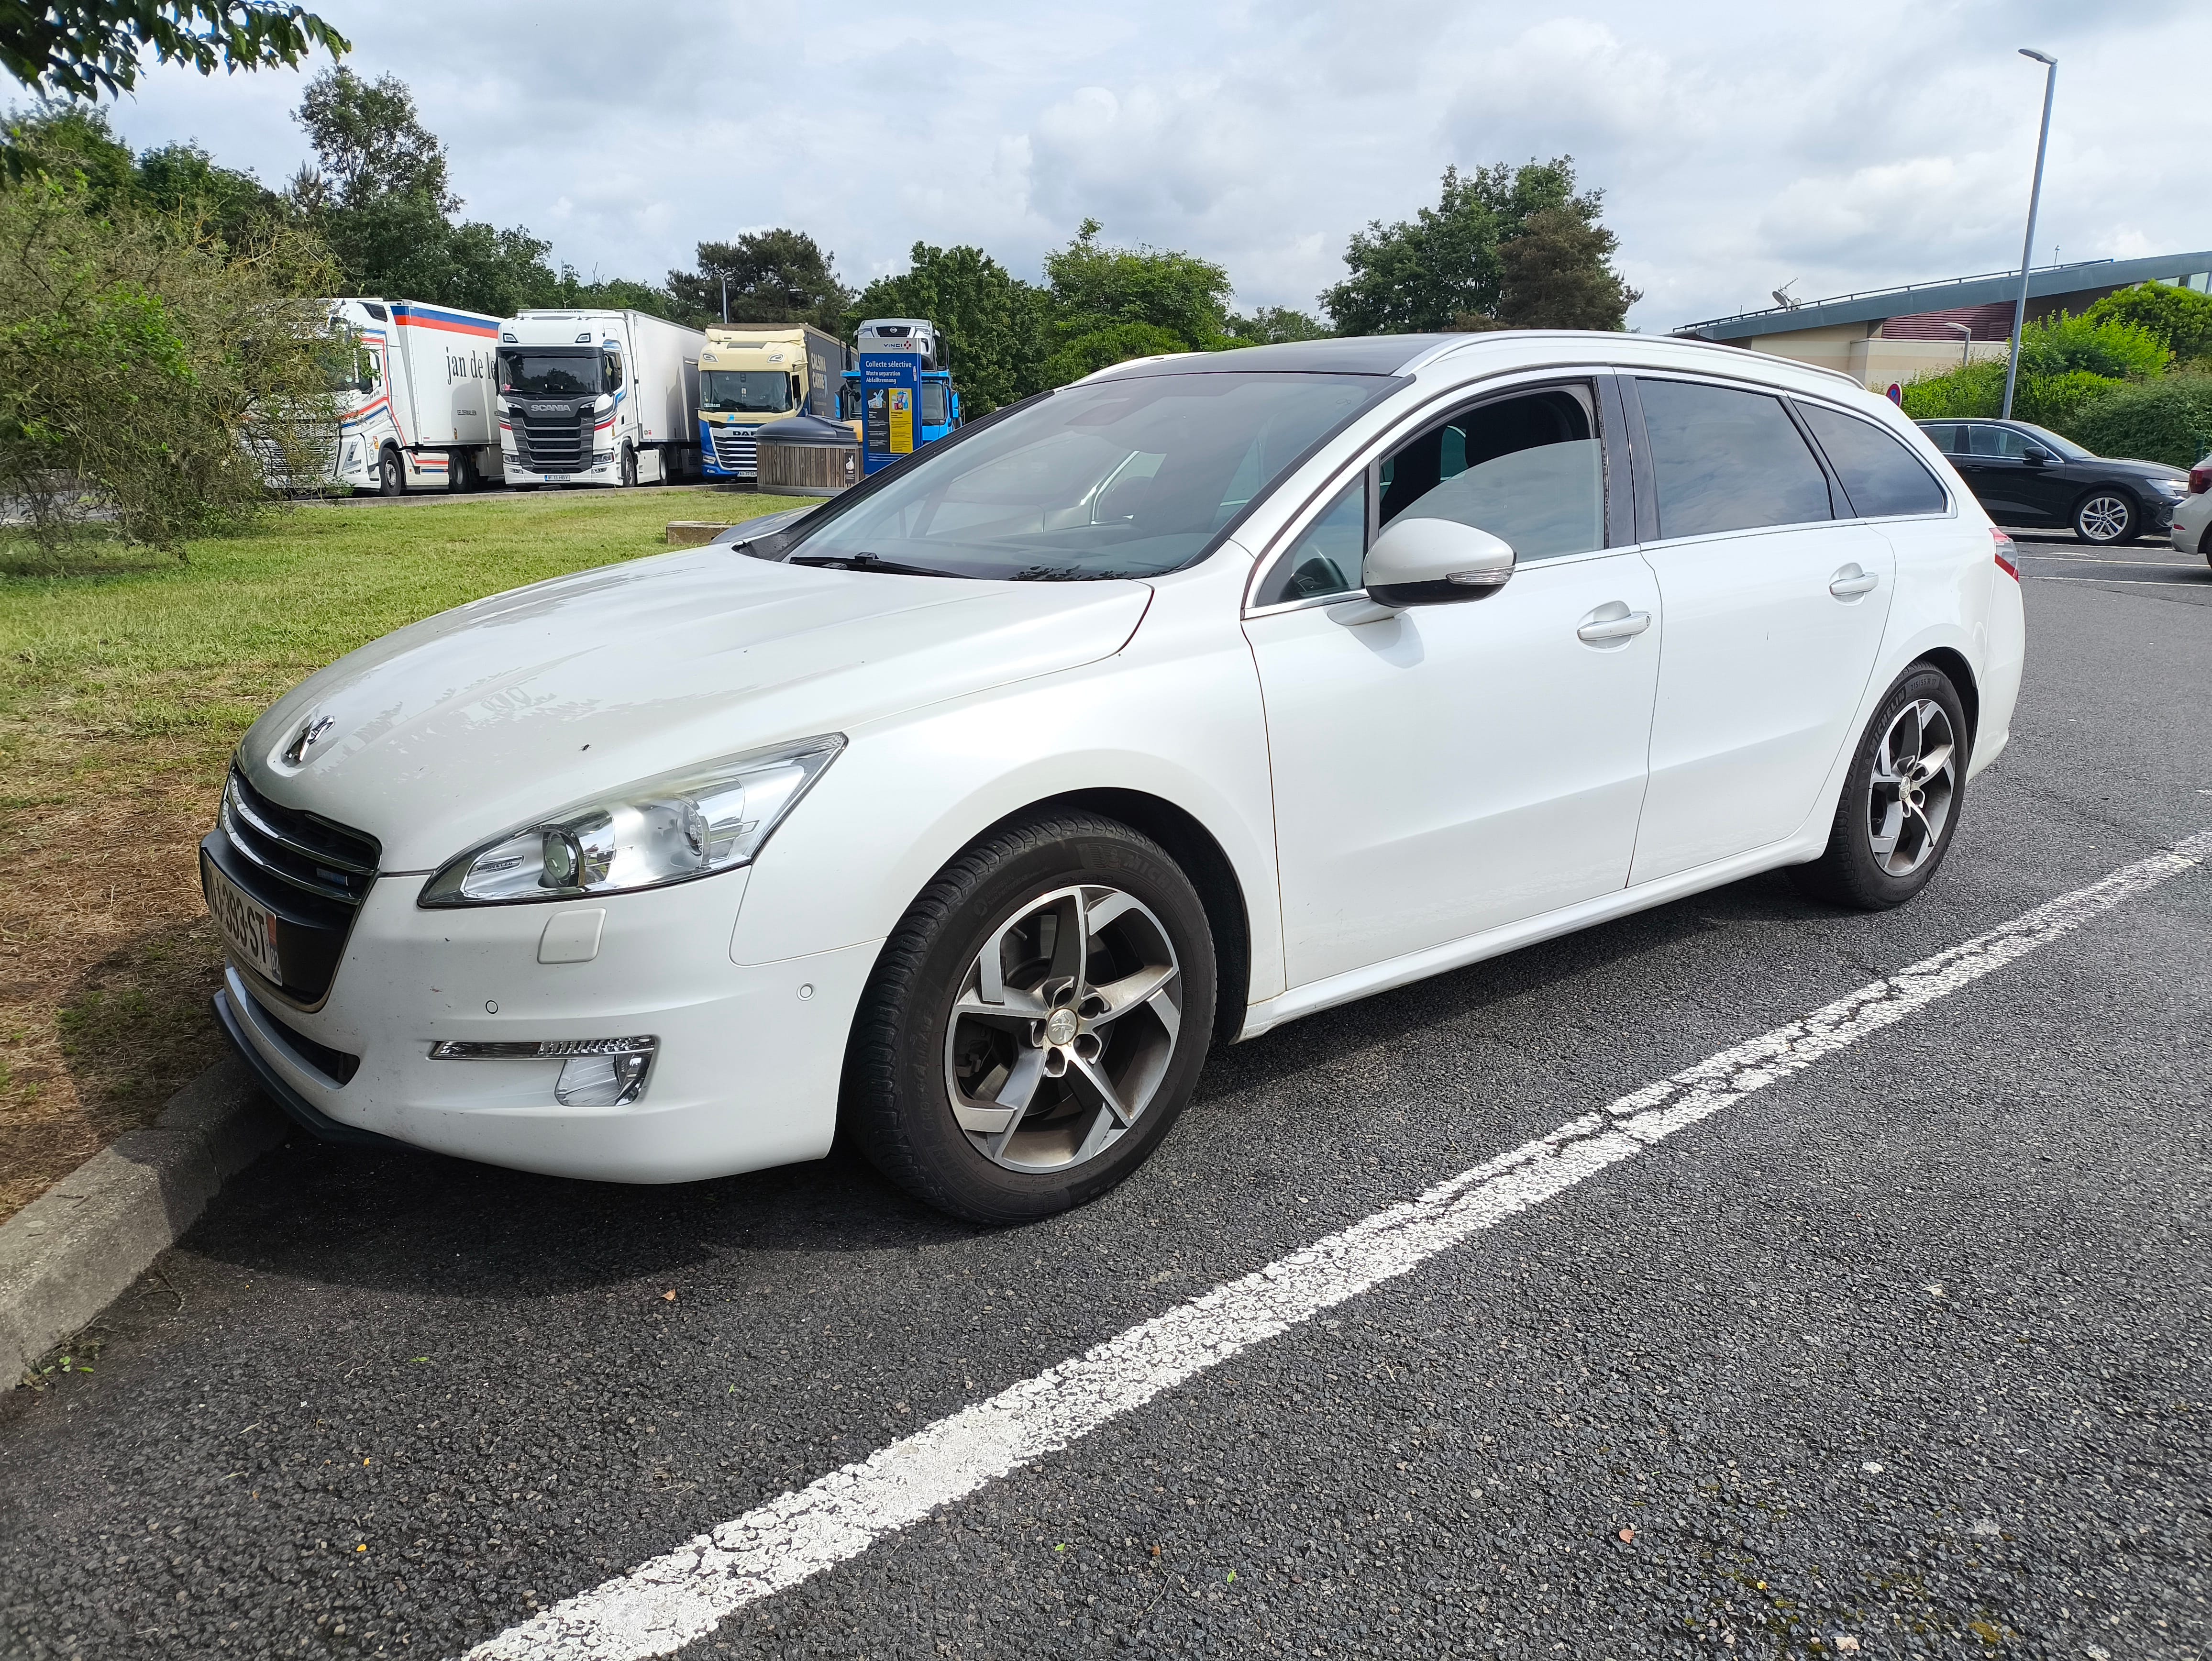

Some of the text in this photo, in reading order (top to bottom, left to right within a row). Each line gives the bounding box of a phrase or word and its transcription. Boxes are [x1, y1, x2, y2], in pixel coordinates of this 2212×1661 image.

[446, 346, 467, 385] jan
[470, 350, 484, 379] de
[1910, 678, 1926, 691] 215/55
[1869, 689, 1905, 755] MICHELIN
[270, 947, 281, 975] 82
